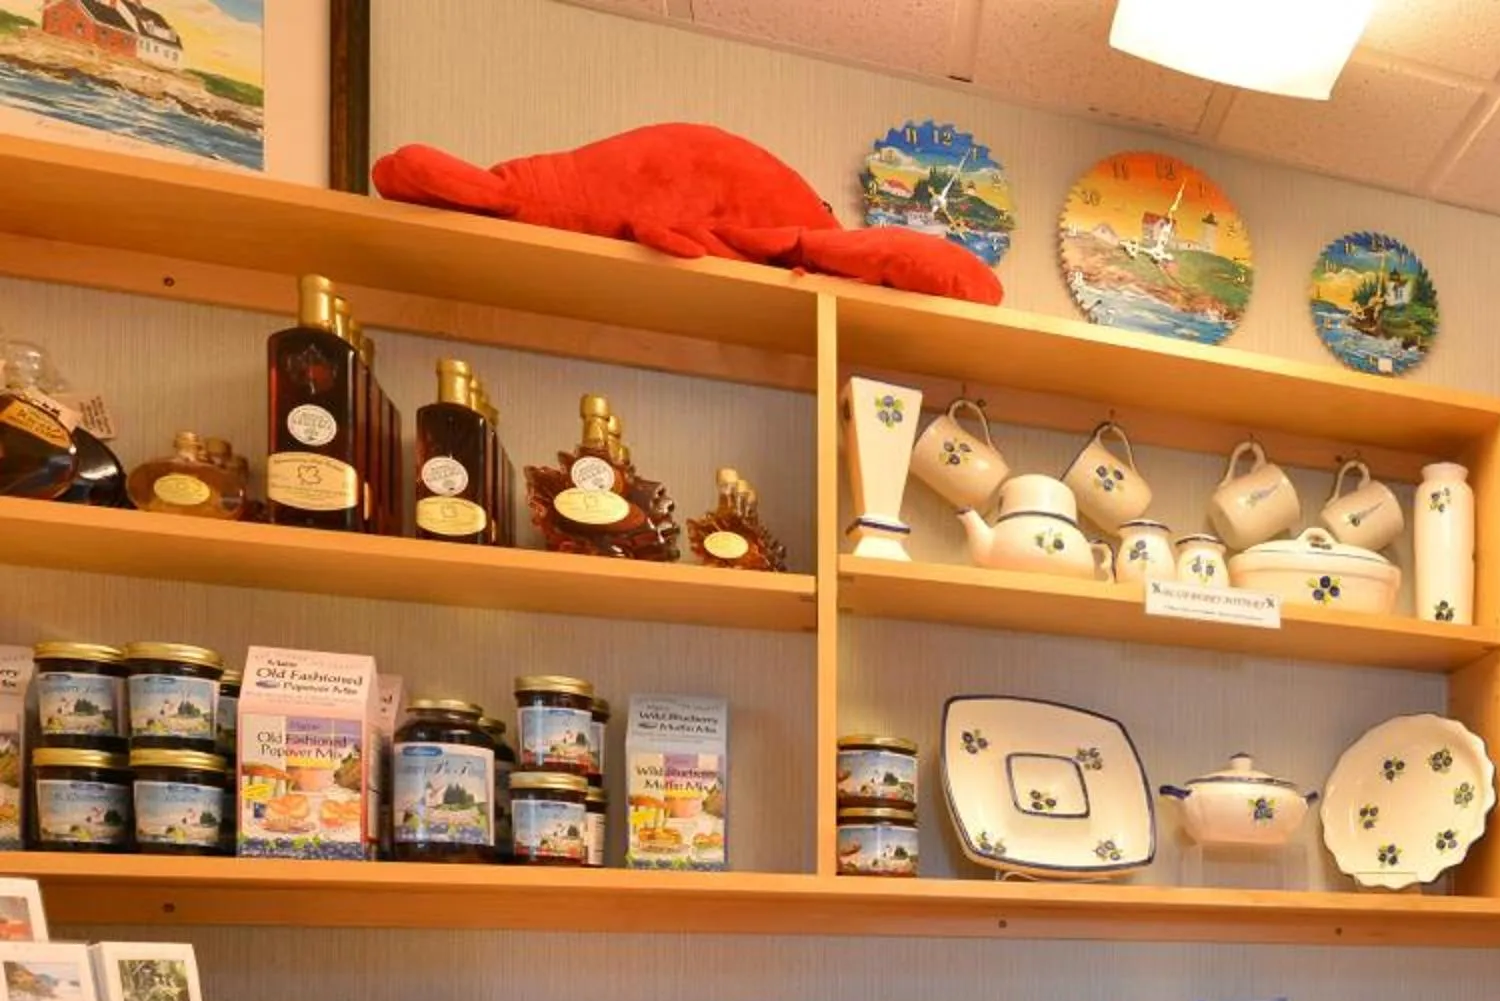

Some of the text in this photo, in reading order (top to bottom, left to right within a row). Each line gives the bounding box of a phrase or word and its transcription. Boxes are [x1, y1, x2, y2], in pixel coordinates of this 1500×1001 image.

[255, 667, 364, 687] Old Fashioned
[257, 731, 348, 749] Old Fashioned
[260, 743, 343, 760] Popover Mix
